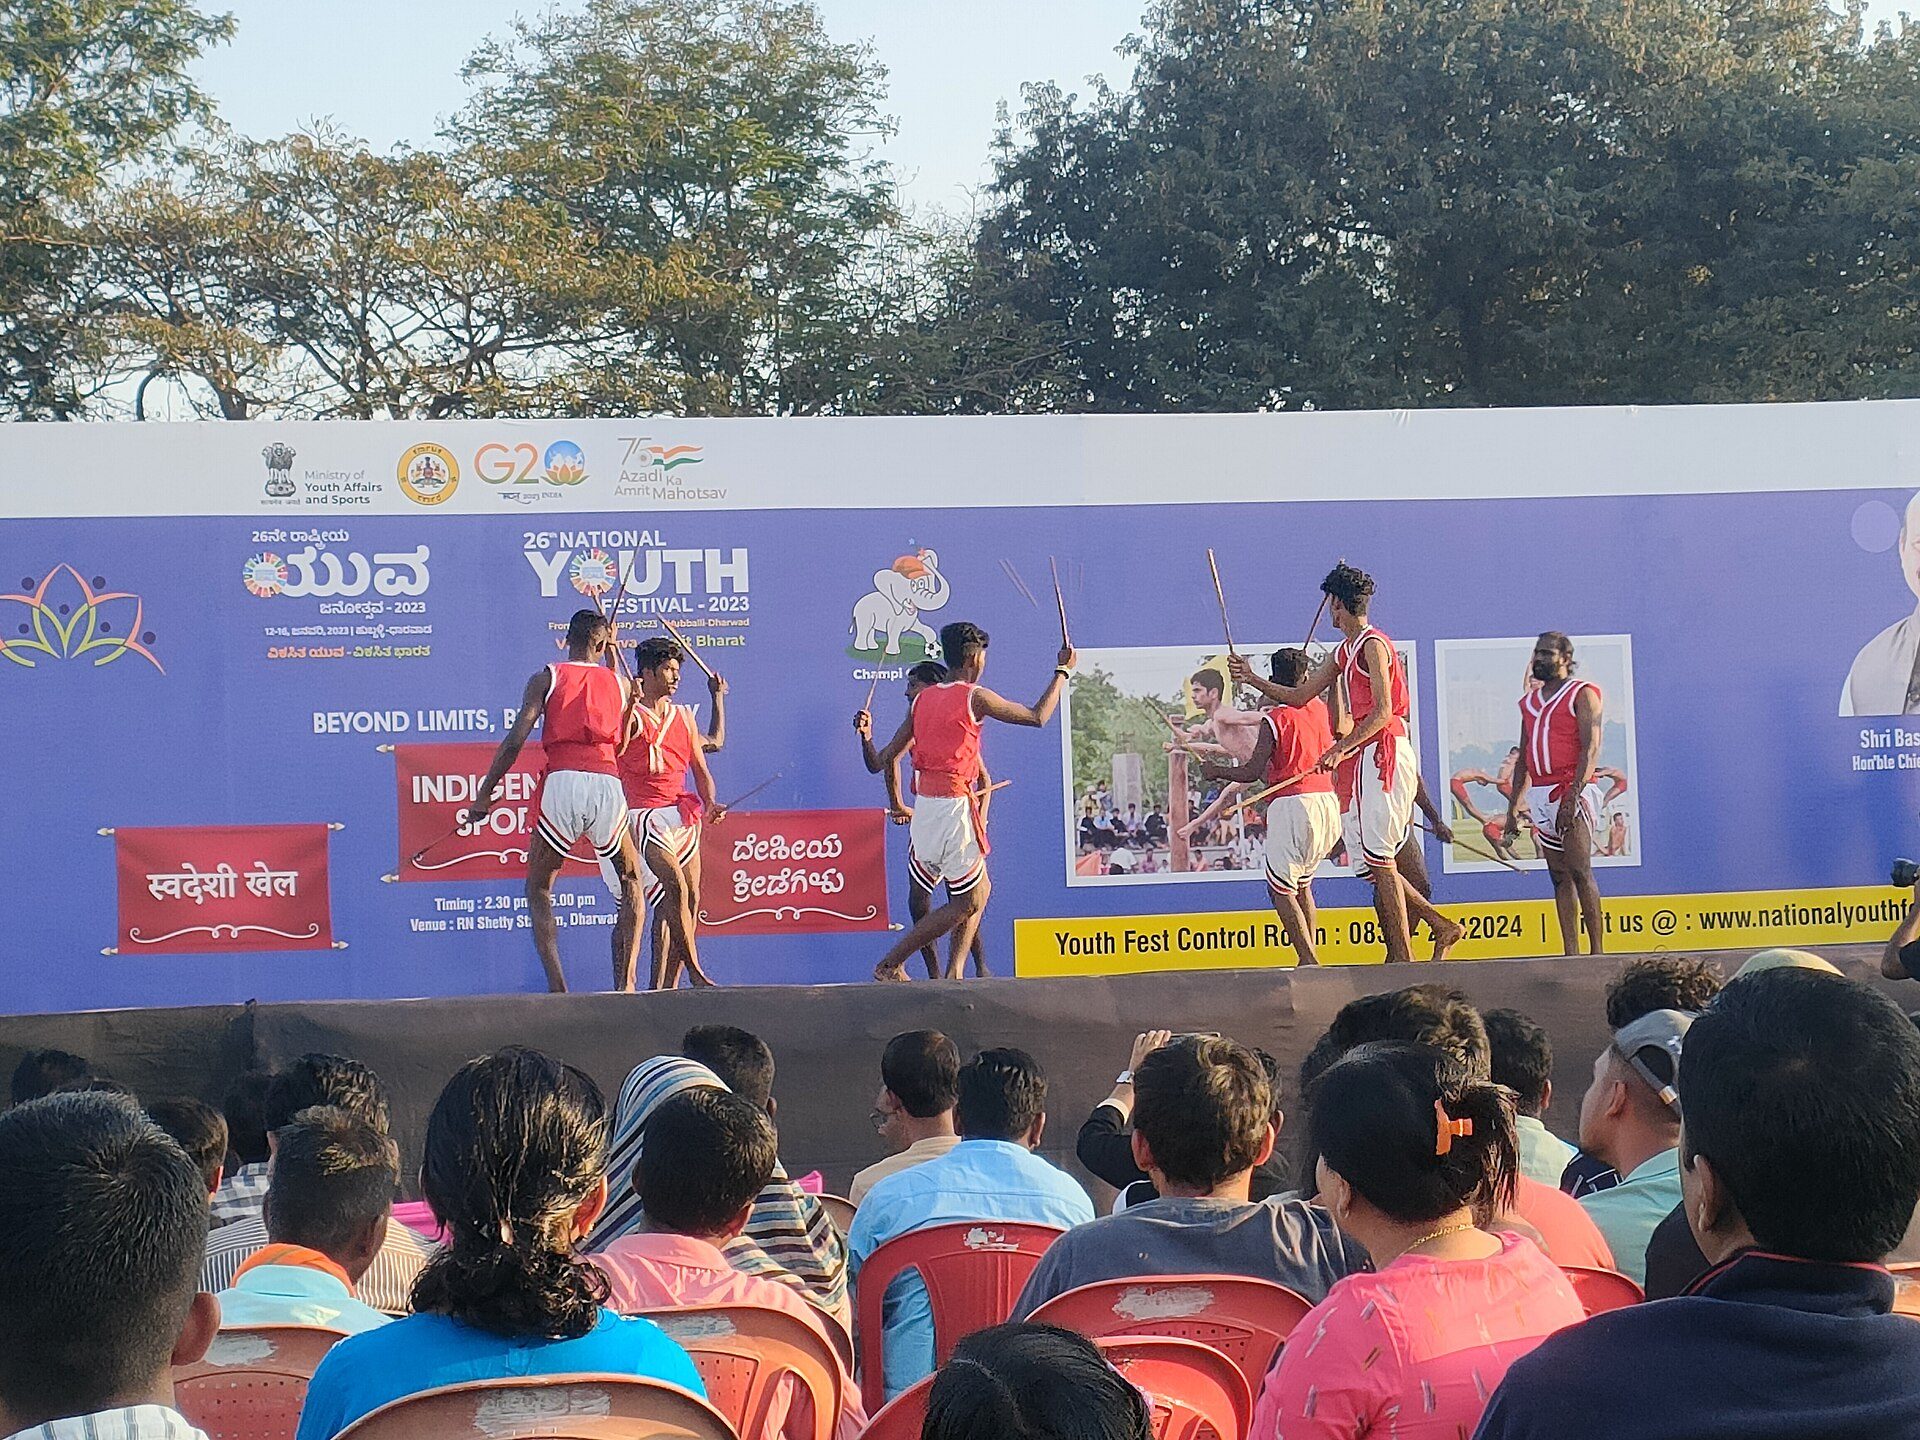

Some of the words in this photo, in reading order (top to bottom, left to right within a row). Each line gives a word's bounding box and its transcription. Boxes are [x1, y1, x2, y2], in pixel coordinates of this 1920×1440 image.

[474, 440, 589, 486] G20
[305, 471, 351, 481] Ministry
[353, 470, 365, 480] of
[619, 469, 662, 482] Azadi
[666, 476, 682, 486] Ka
[305, 482, 340, 492] Youth
[344, 482, 382, 492] Affairs
[614, 485, 650, 496] Amrit
[653, 487, 727, 499] Mahotsav
[305, 495, 328, 504] and
[332, 494, 370, 505] Sports
[252, 528, 287, 543] 26ನೇ
[559, 530, 667, 548] NATIONAL
[394, 602, 426, 613] 2023
[601, 597, 693, 614] FESTIVAL
[708, 596, 750, 612] 2023
[696, 635, 746, 647] Bharat
[394, 645, 431, 659] ಭಾರತ
[853, 667, 903, 682] Champi
[312, 711, 410, 734] BEYOND
[417, 708, 495, 733] LIMITS,
[1860, 728, 1891, 749] Shri
[146, 862, 238, 905] स्वदेशी
[243, 861, 299, 897] खेल
[731, 867, 845, 903] ಕ್ರೀಡೆಗಳು
[434, 898, 475, 913] Timing
[484, 895, 511, 909] 2.30
[577, 894, 596, 909] pm
[410, 918, 447, 932] Venue
[456, 916, 474, 930] RN
[477, 915, 514, 931] Shetty
[1619, 915, 1644, 933] us
[1651, 908, 1678, 936] @
[1055, 931, 1116, 956] Youth
[1124, 929, 1170, 954] Fest
[1177, 925, 1255, 951] Control
